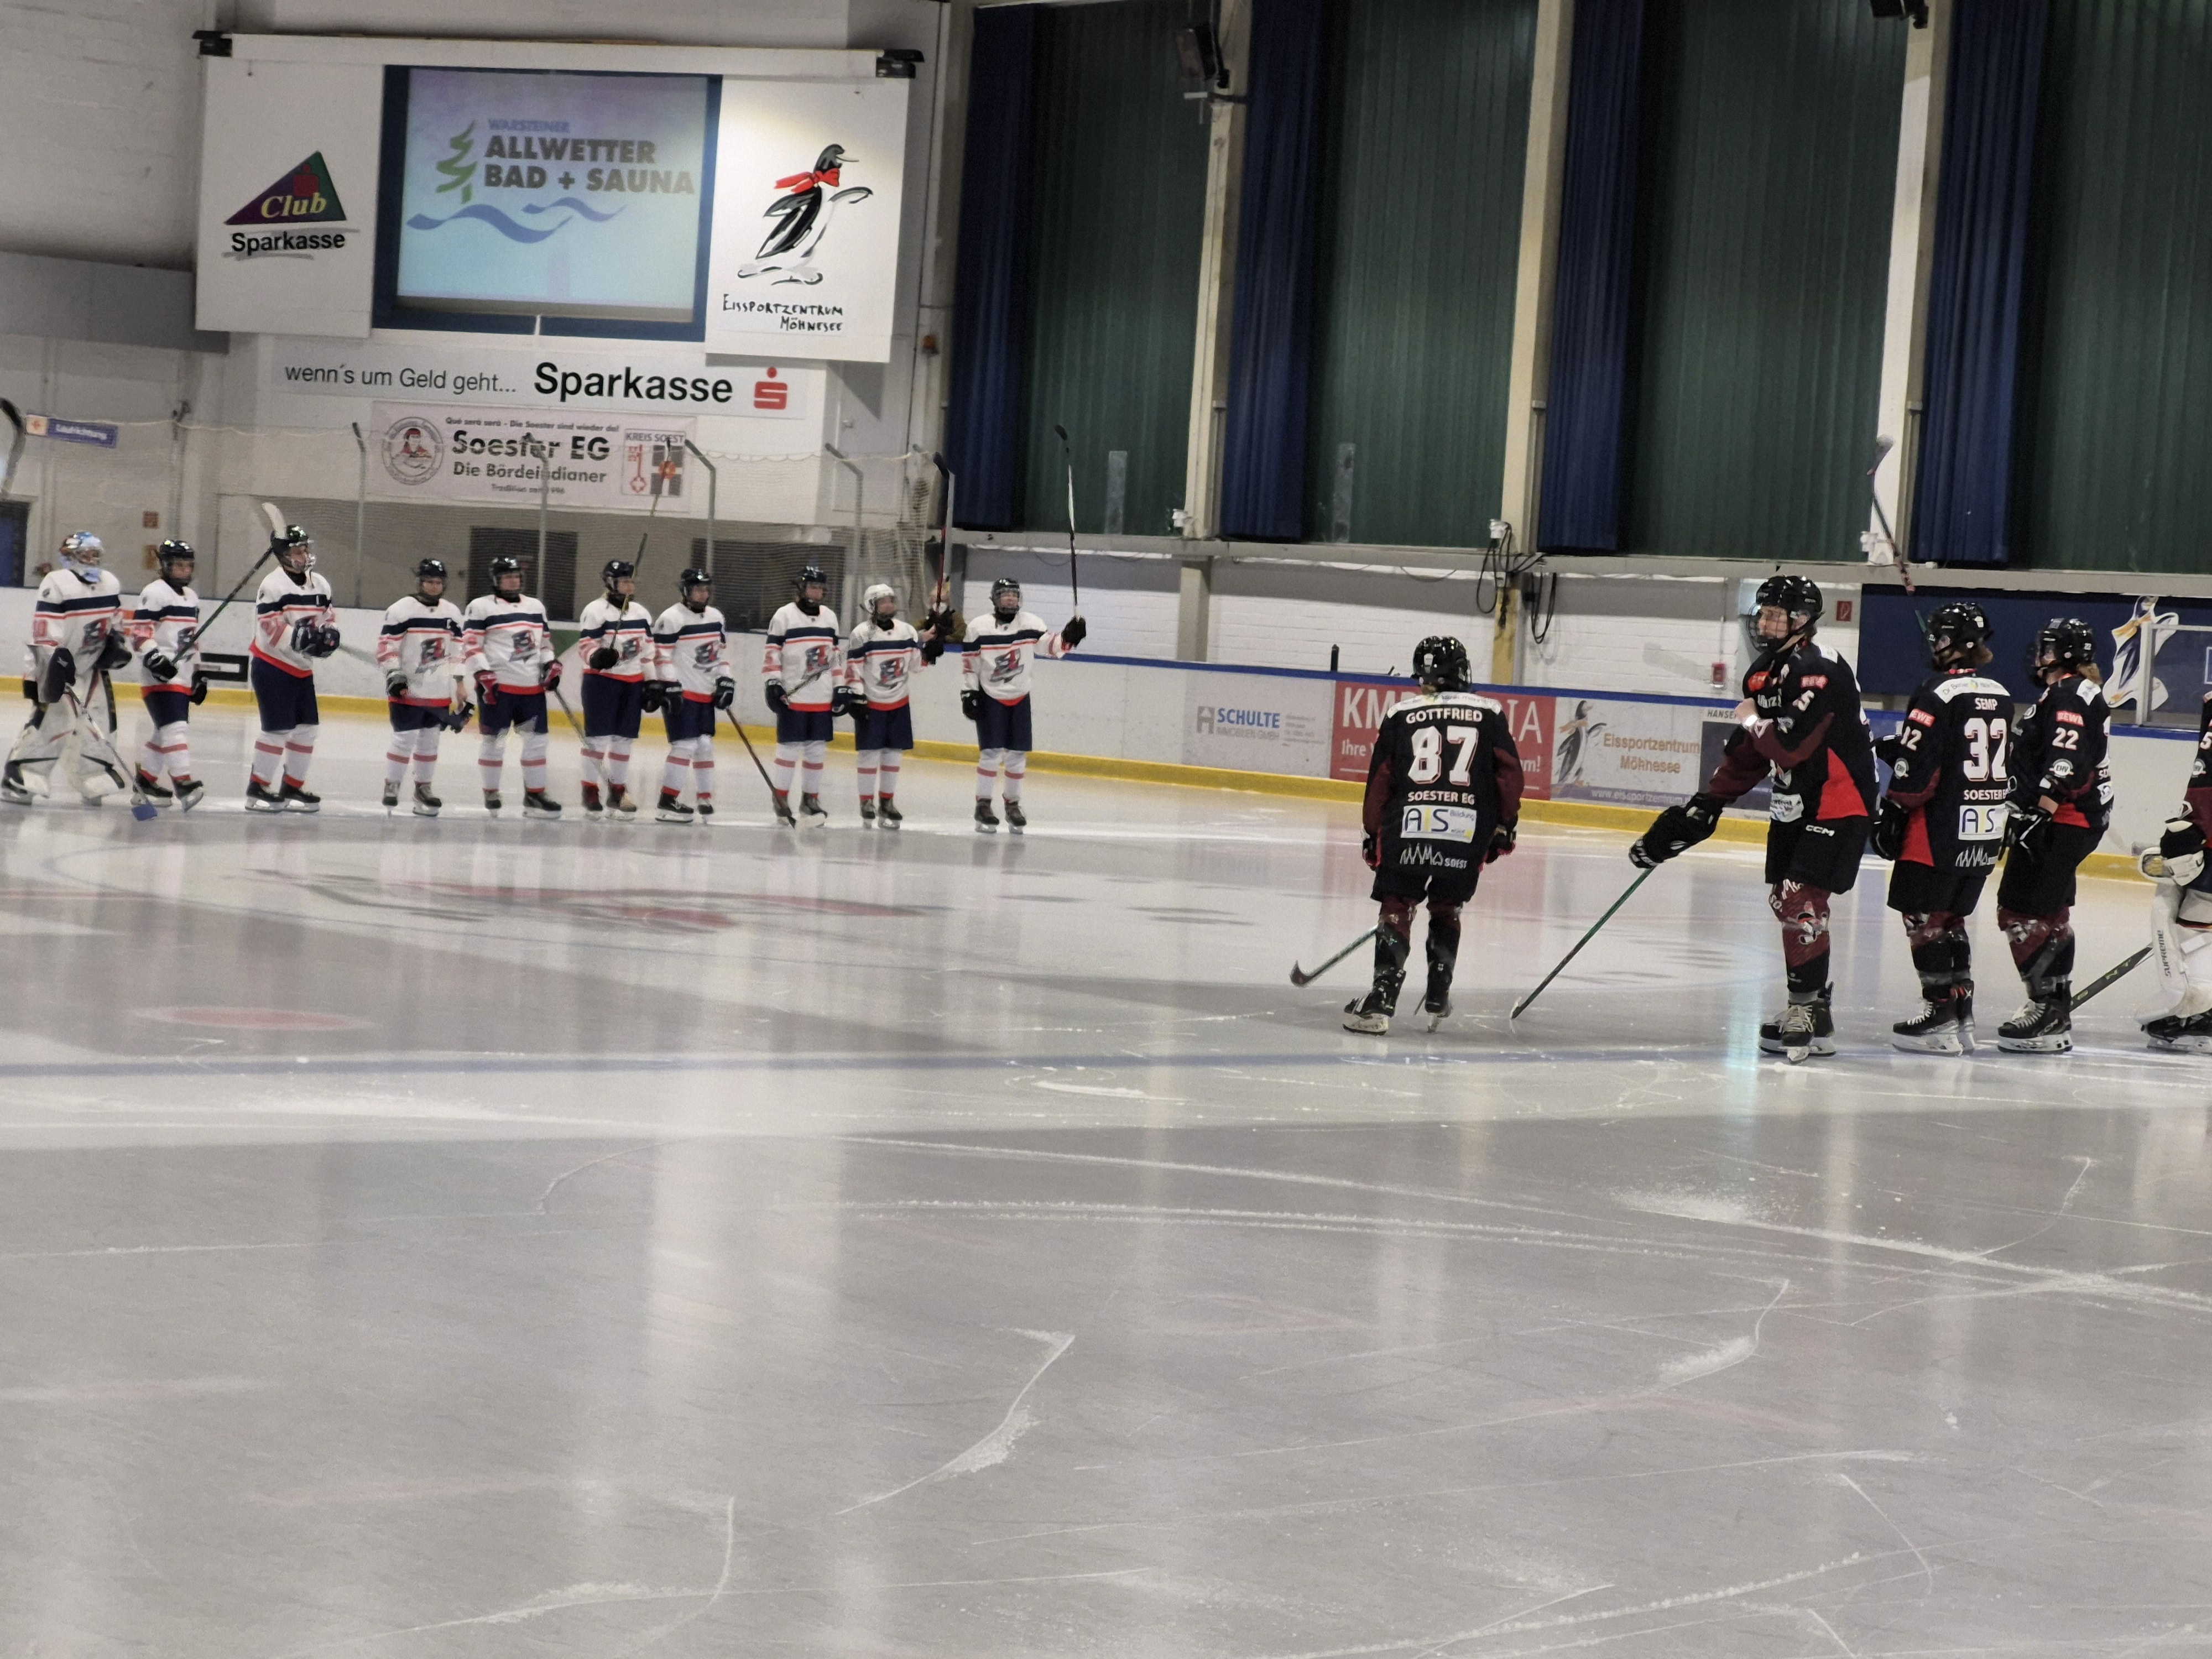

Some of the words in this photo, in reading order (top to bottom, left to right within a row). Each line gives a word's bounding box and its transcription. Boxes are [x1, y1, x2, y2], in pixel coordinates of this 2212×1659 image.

[484, 135, 656, 164] ALLWETTER
[485, 164, 547, 189] BAD
[558, 171, 576, 190] +
[587, 168, 695, 195] SAUNA
[261, 192, 327, 218] Club
[232, 231, 345, 256] Sparkasse
[362, 371, 392, 386] um
[399, 368, 446, 389] Geld
[453, 372, 517, 395] geht...
[534, 362, 733, 403] Sparkasse
[626, 432, 652, 441] KREIS
[570, 435, 610, 461] EG
[453, 461, 480, 477] Die
[486, 463, 607, 483] Bördeidianer
[1974, 697, 1998, 711] SEMP
[1218, 707, 1281, 728] SCHULTE
[1406, 707, 1483, 724] GOTTFRIED
[2057, 712, 2084, 726] REWE
[1341, 738, 1366, 757] Ihre
[1604, 733, 1701, 754] Eissportzentrum
[2052, 727, 2079, 750] 22
[1408, 726, 1479, 786] 87
[1963, 717, 2008, 782] 32
[1620, 755, 1681, 774] Möhnesee
[1407, 790, 1459, 802] SOESTER
[1461, 792, 1475, 805] EG
[1806, 825, 1835, 837] CCM
